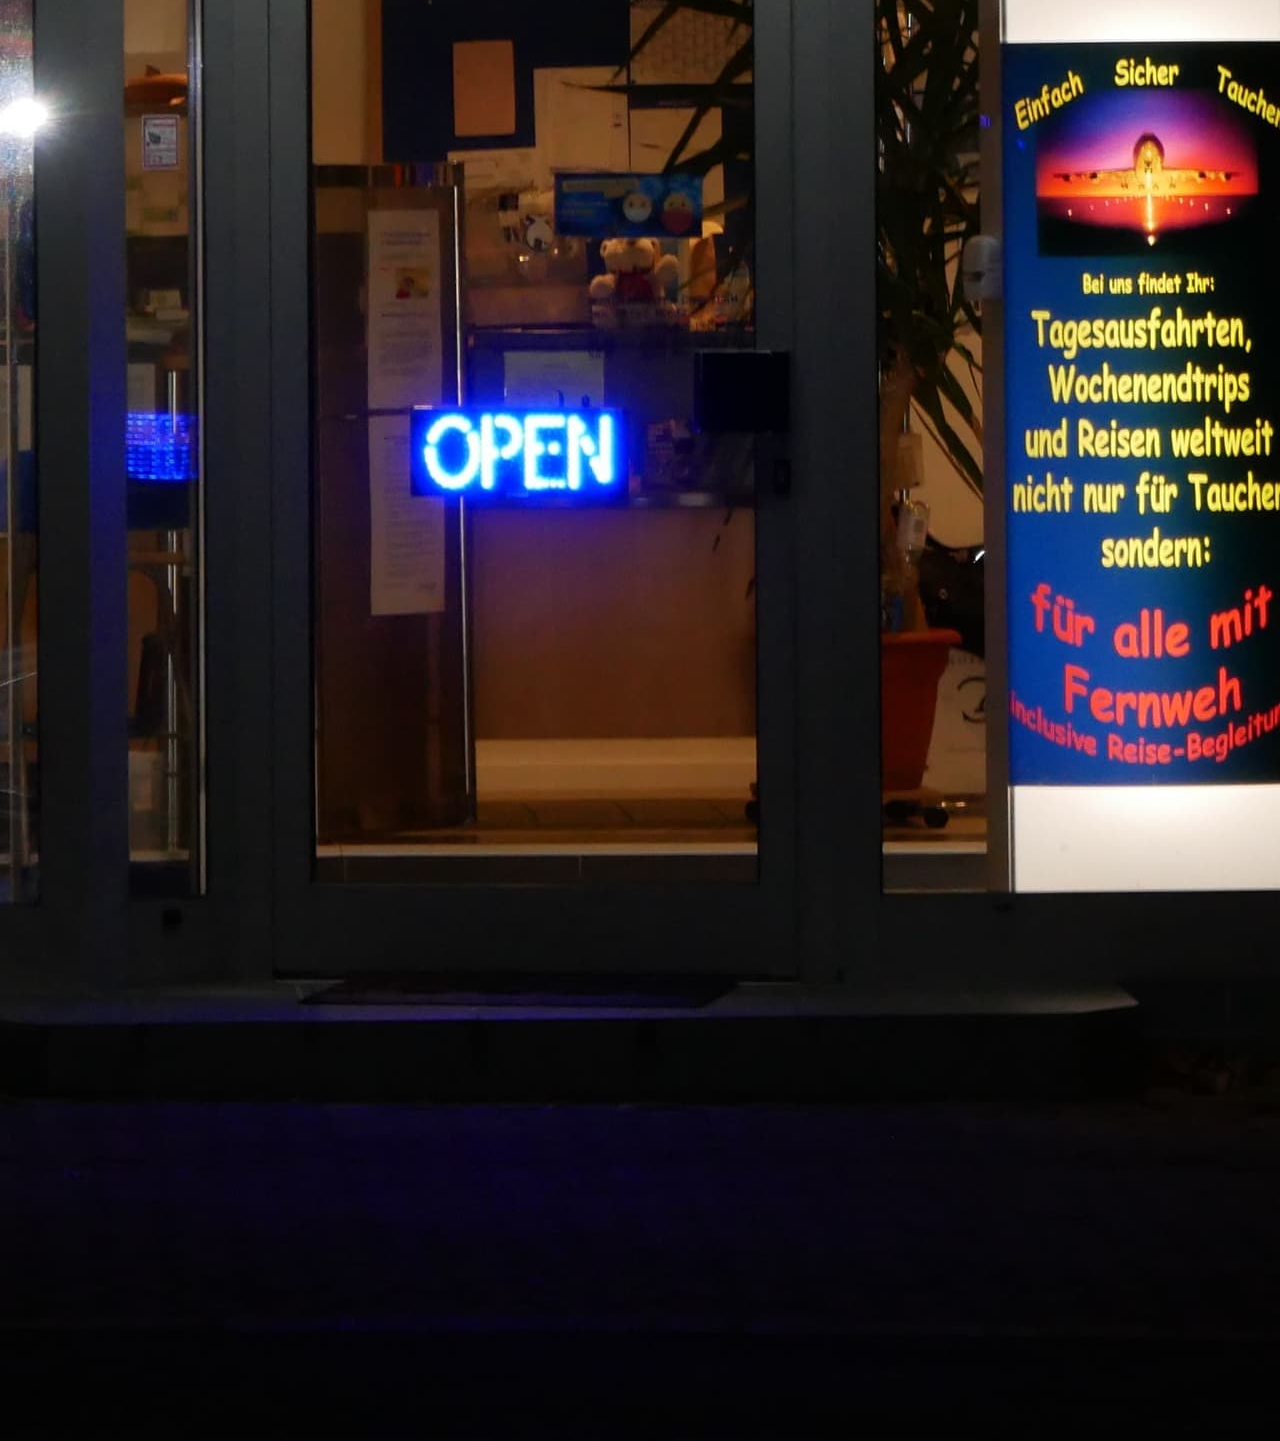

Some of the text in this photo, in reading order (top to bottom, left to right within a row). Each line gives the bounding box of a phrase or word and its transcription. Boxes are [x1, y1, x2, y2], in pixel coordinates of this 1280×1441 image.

[1014, 70, 1084, 131] Einfach
[1114, 57, 1180, 87] Sicher
[1082, 272, 1215, 295] Bei uns findet Ihr:
[1031, 307, 1252, 359] Tagesausfahrten,
[1048, 361, 1250, 413] Wochenendtrips
[422, 412, 616, 491] OPEN
[1025, 416, 1274, 458] und Reisen weltweit
[1013, 471, 1074, 513] nicht
[1083, 482, 1125, 513] nur
[1135, 471, 1178, 515] für
[1101, 526, 1211, 568] sondern:
[1030, 582, 1274, 658] für alle mit
[1063, 663, 1243, 729] Fernweh
[1010, 689, 1098, 756] inclusive
